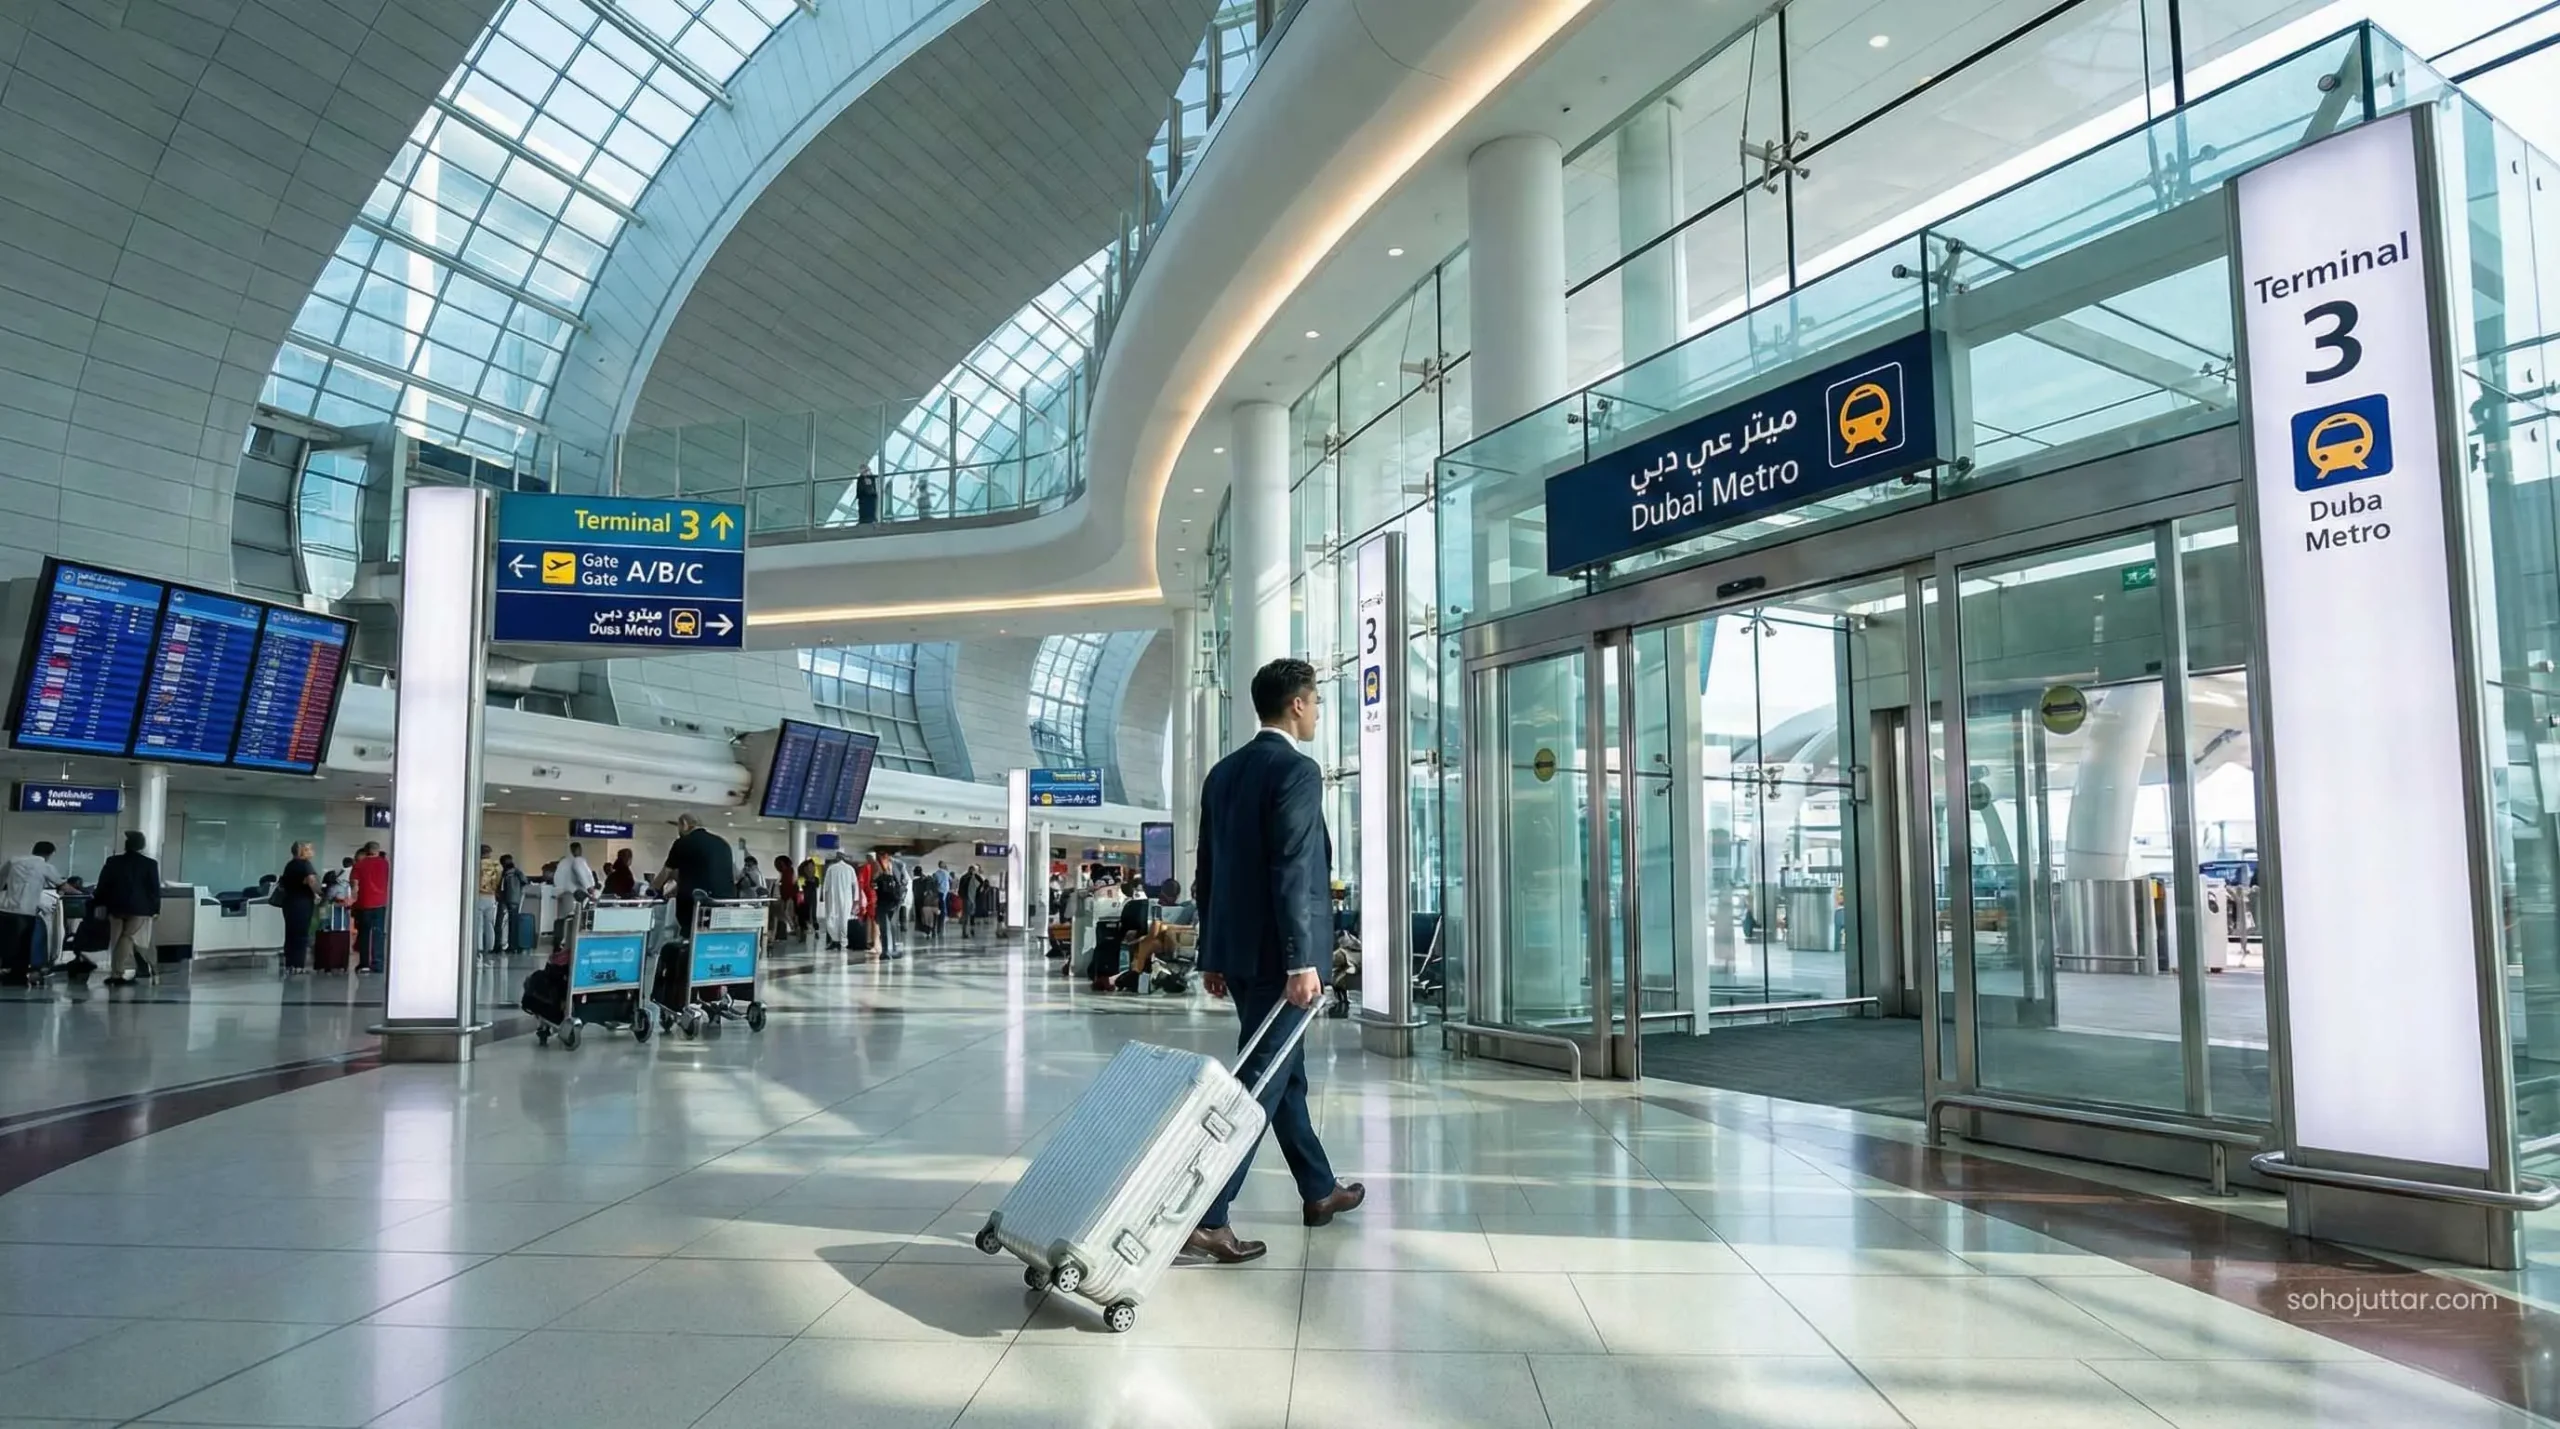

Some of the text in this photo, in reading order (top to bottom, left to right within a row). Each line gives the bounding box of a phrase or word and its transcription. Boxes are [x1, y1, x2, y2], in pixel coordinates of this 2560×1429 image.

[2253, 230, 2409, 304] Terminal
[2303, 299, 2362, 384] 3
[1631, 459, 1799, 532] Dubai Metro
[2309, 492, 2382, 522] Duba
[574, 509, 700, 541] Terminal 3
[2305, 521, 2391, 552] Metro
[582, 553, 619, 569] Gate
[626, 560, 704, 585] A/B/C
[582, 571, 618, 587] Gate
[1366, 617, 1377, 655] 3
